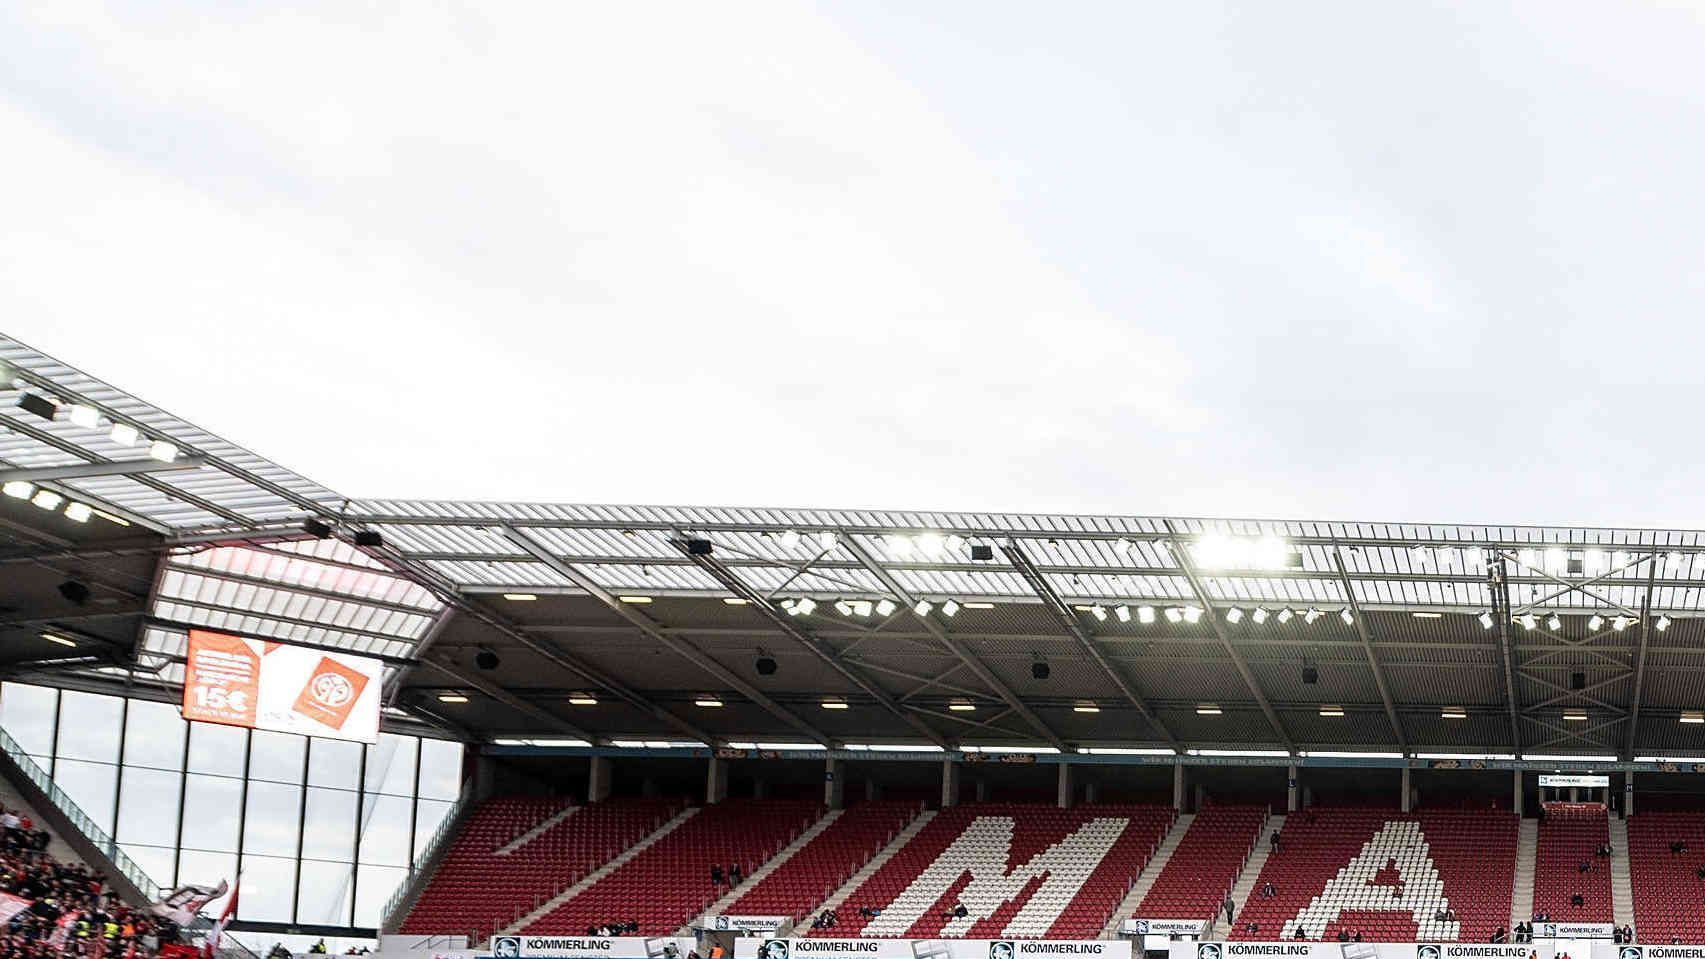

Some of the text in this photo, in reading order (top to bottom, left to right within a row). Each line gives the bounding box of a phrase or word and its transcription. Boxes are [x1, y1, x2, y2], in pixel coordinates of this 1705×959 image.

[192, 686, 249, 712] 15€
[732, 919, 778, 928] KÖMMERLING
[1151, 922, 1197, 931] KÖMMERLING
[1559, 926, 1604, 935] KÖMMERLING
[527, 938, 611, 950] KÖMMERLING
[795, 939, 878, 952] KÖMMERLING
[1020, 942, 1102, 954] KÖMMERLING
[1228, 943, 1308, 956] KÖMMERLING
[1447, 945, 1526, 957] KÖMMERLING
